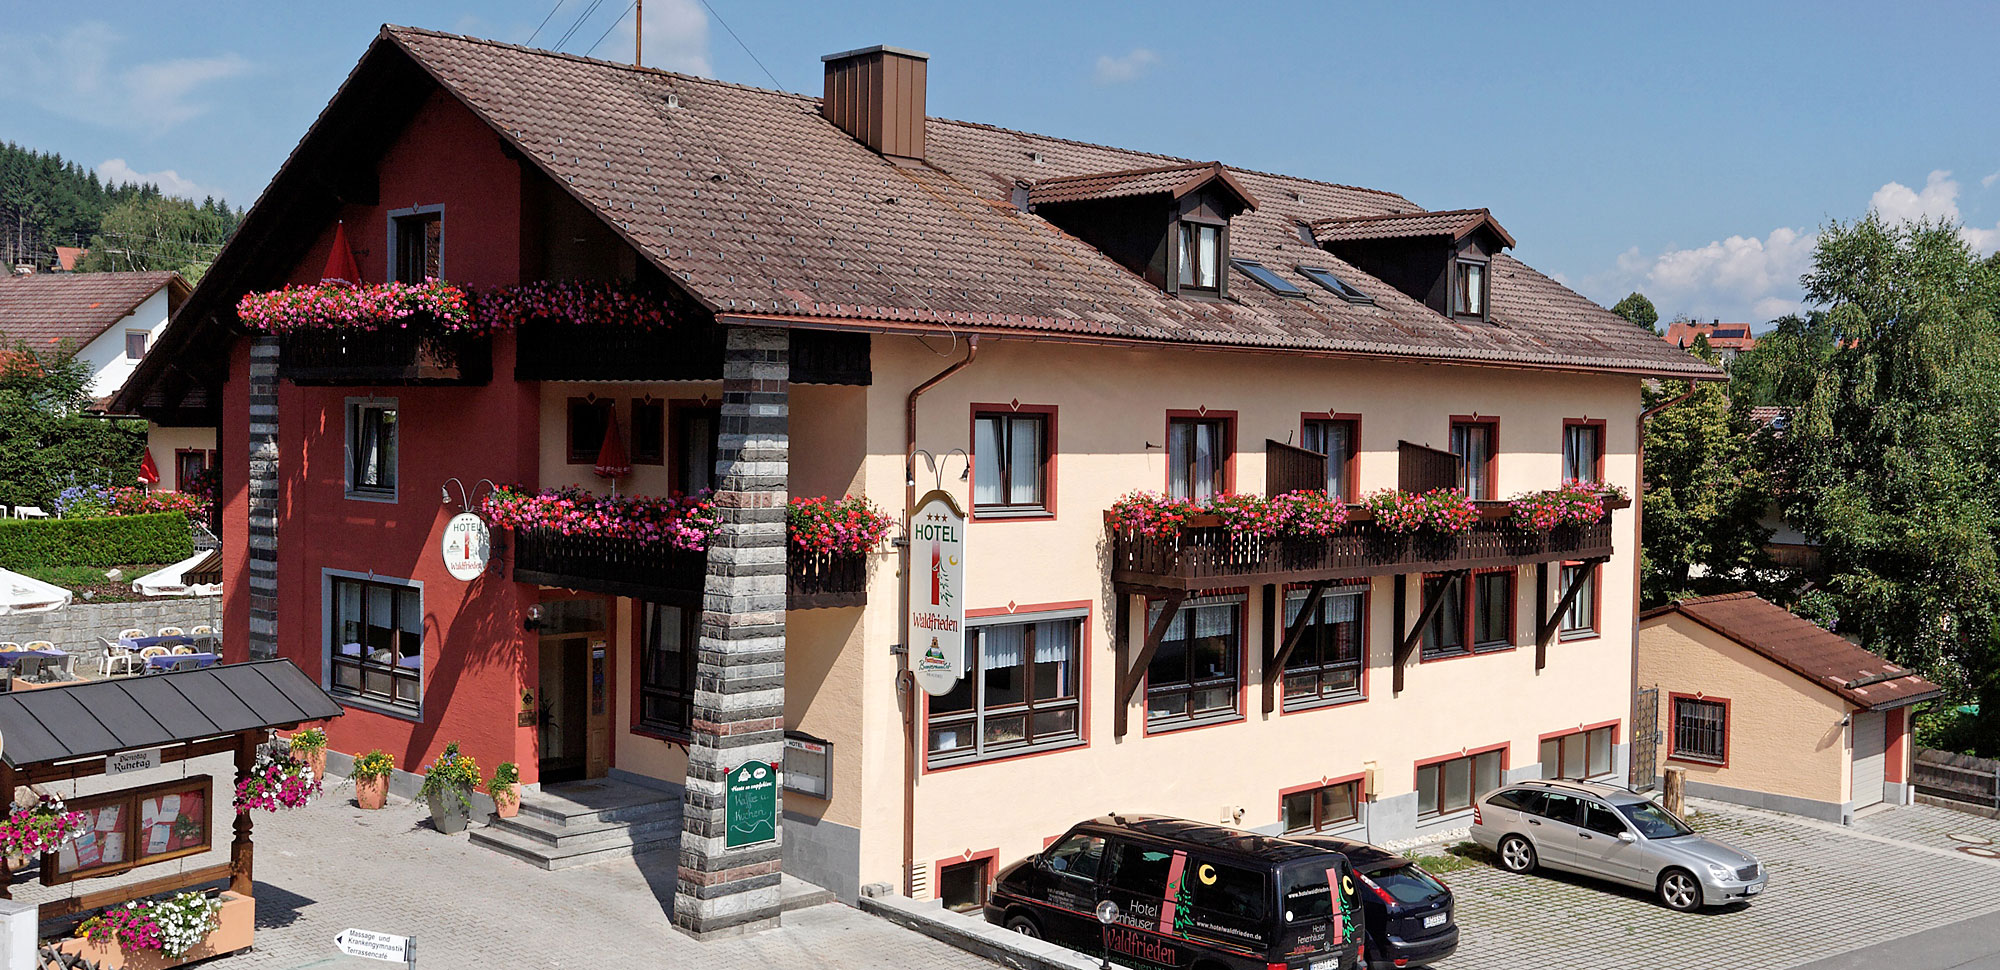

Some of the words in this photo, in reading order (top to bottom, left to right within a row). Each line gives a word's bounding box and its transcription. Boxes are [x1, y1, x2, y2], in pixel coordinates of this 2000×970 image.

[454, 523, 481, 531] HOTEL
[915, 524, 958, 543] HOTEL
[912, 612, 958, 632] Waldfrieden
[113, 760, 151, 772] Ruhetag
[735, 808, 767, 821] Kuchen
[1130, 899, 1158, 917] Hotel
[1196, 921, 1262, 941] www.hotelwaldfrieden.de
[1312, 923, 1326, 933] Hotel
[349, 929, 376, 940] Massage
[378, 935, 391, 943] und
[347, 936, 404, 953] Krankengymnastik
[1102, 925, 1176, 965] Waldfrieden
[347, 946, 388, 959] Terrassencafé
